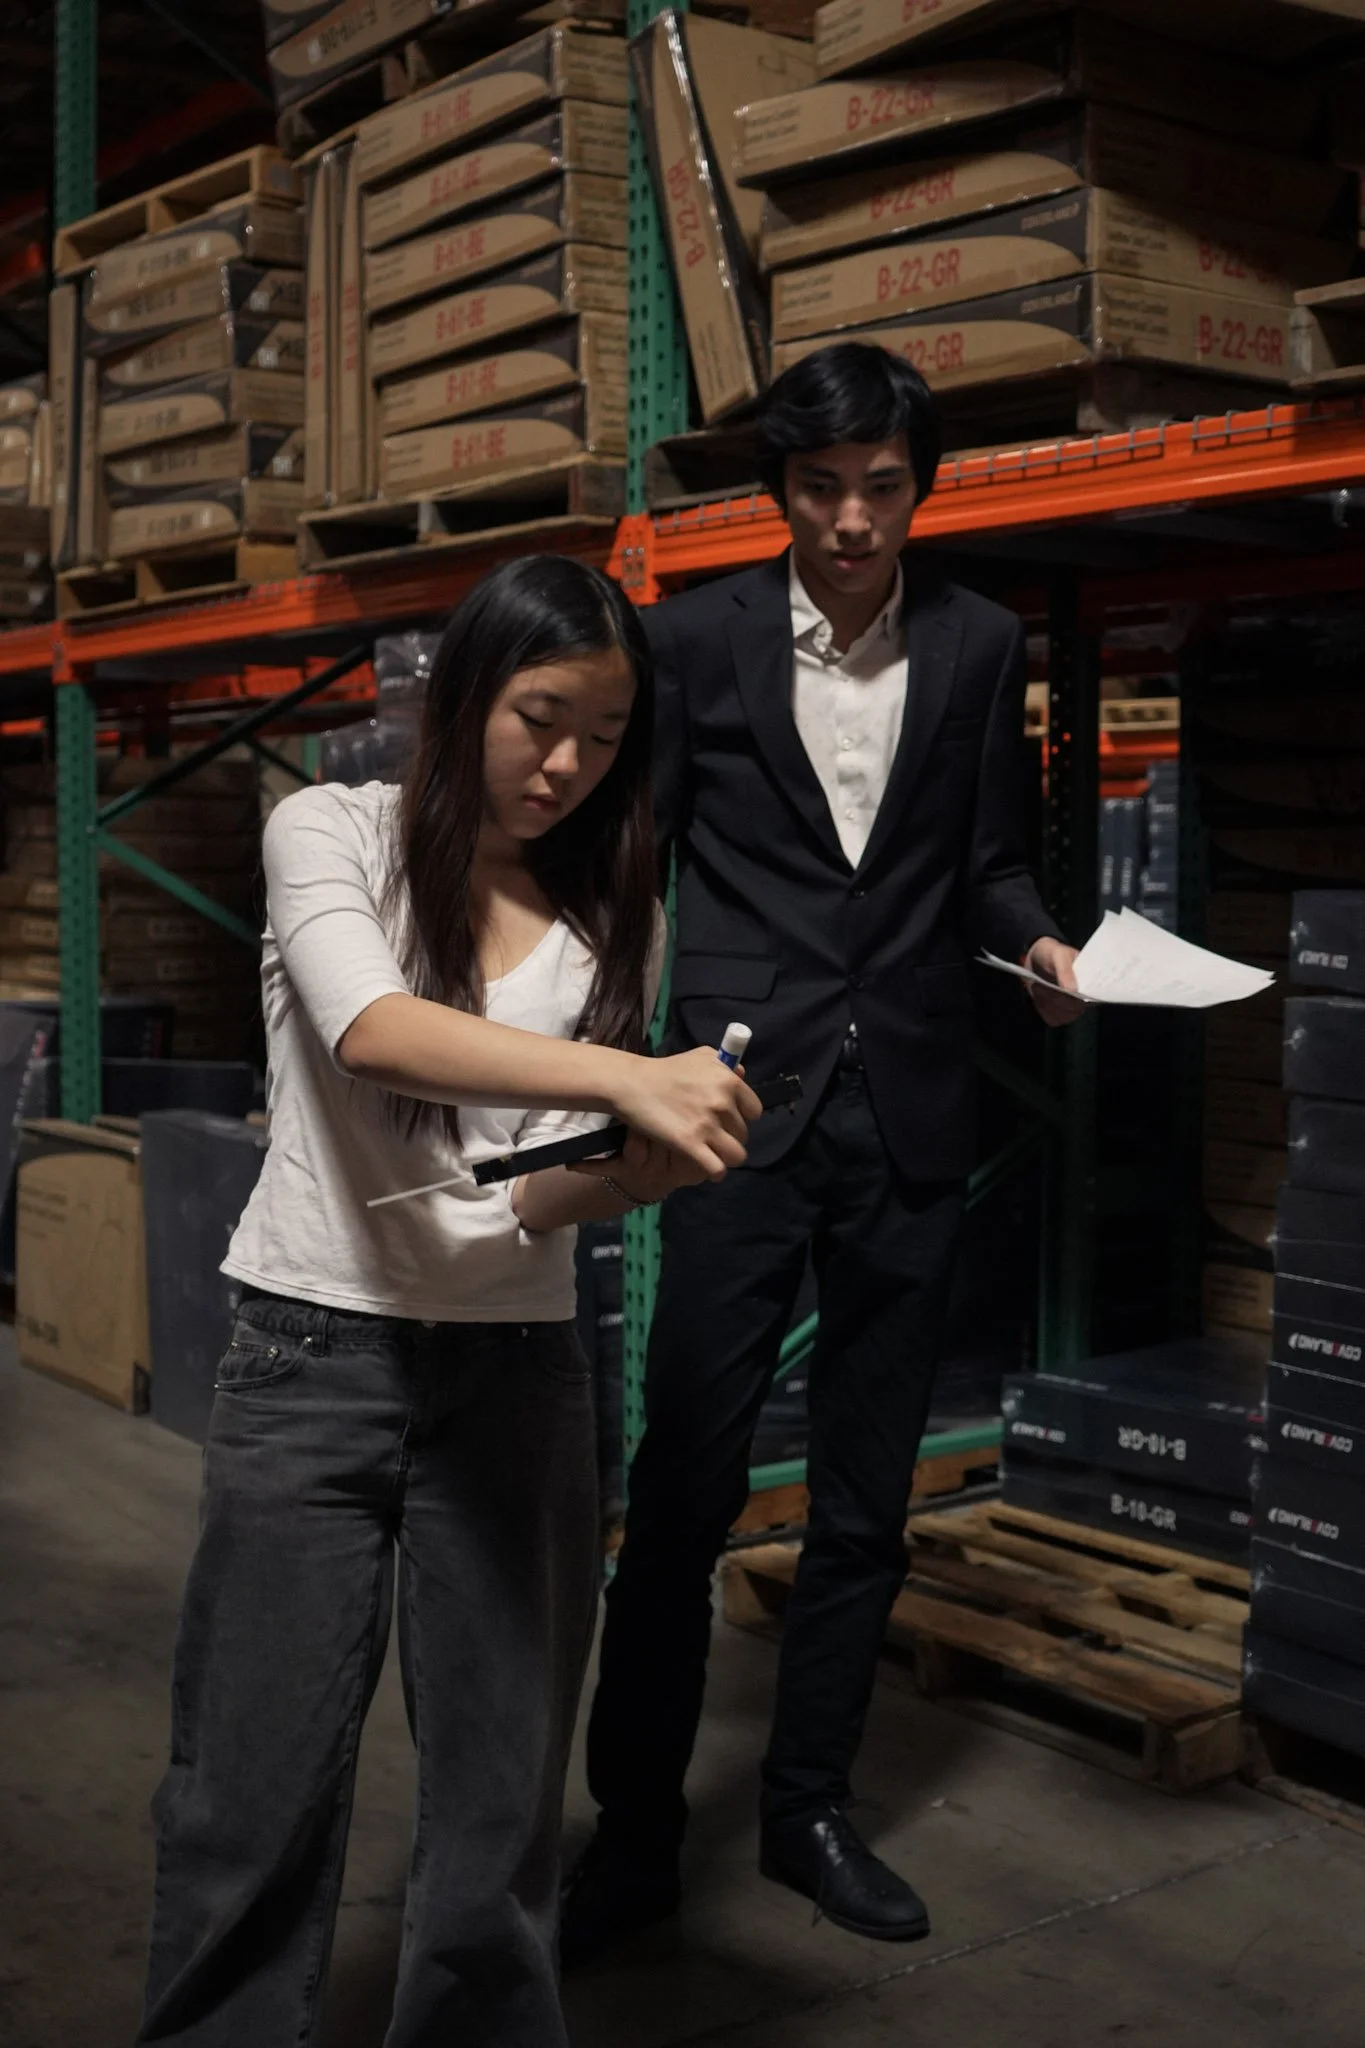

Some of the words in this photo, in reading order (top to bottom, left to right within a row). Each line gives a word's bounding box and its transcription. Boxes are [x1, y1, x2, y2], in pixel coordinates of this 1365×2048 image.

[847, 74, 937, 129] B-22-GR
[877, 248, 960, 299] B-22-GR
[884, 332, 964, 376] 22-GR
[1197, 315, 1283, 365] B-22-GR
